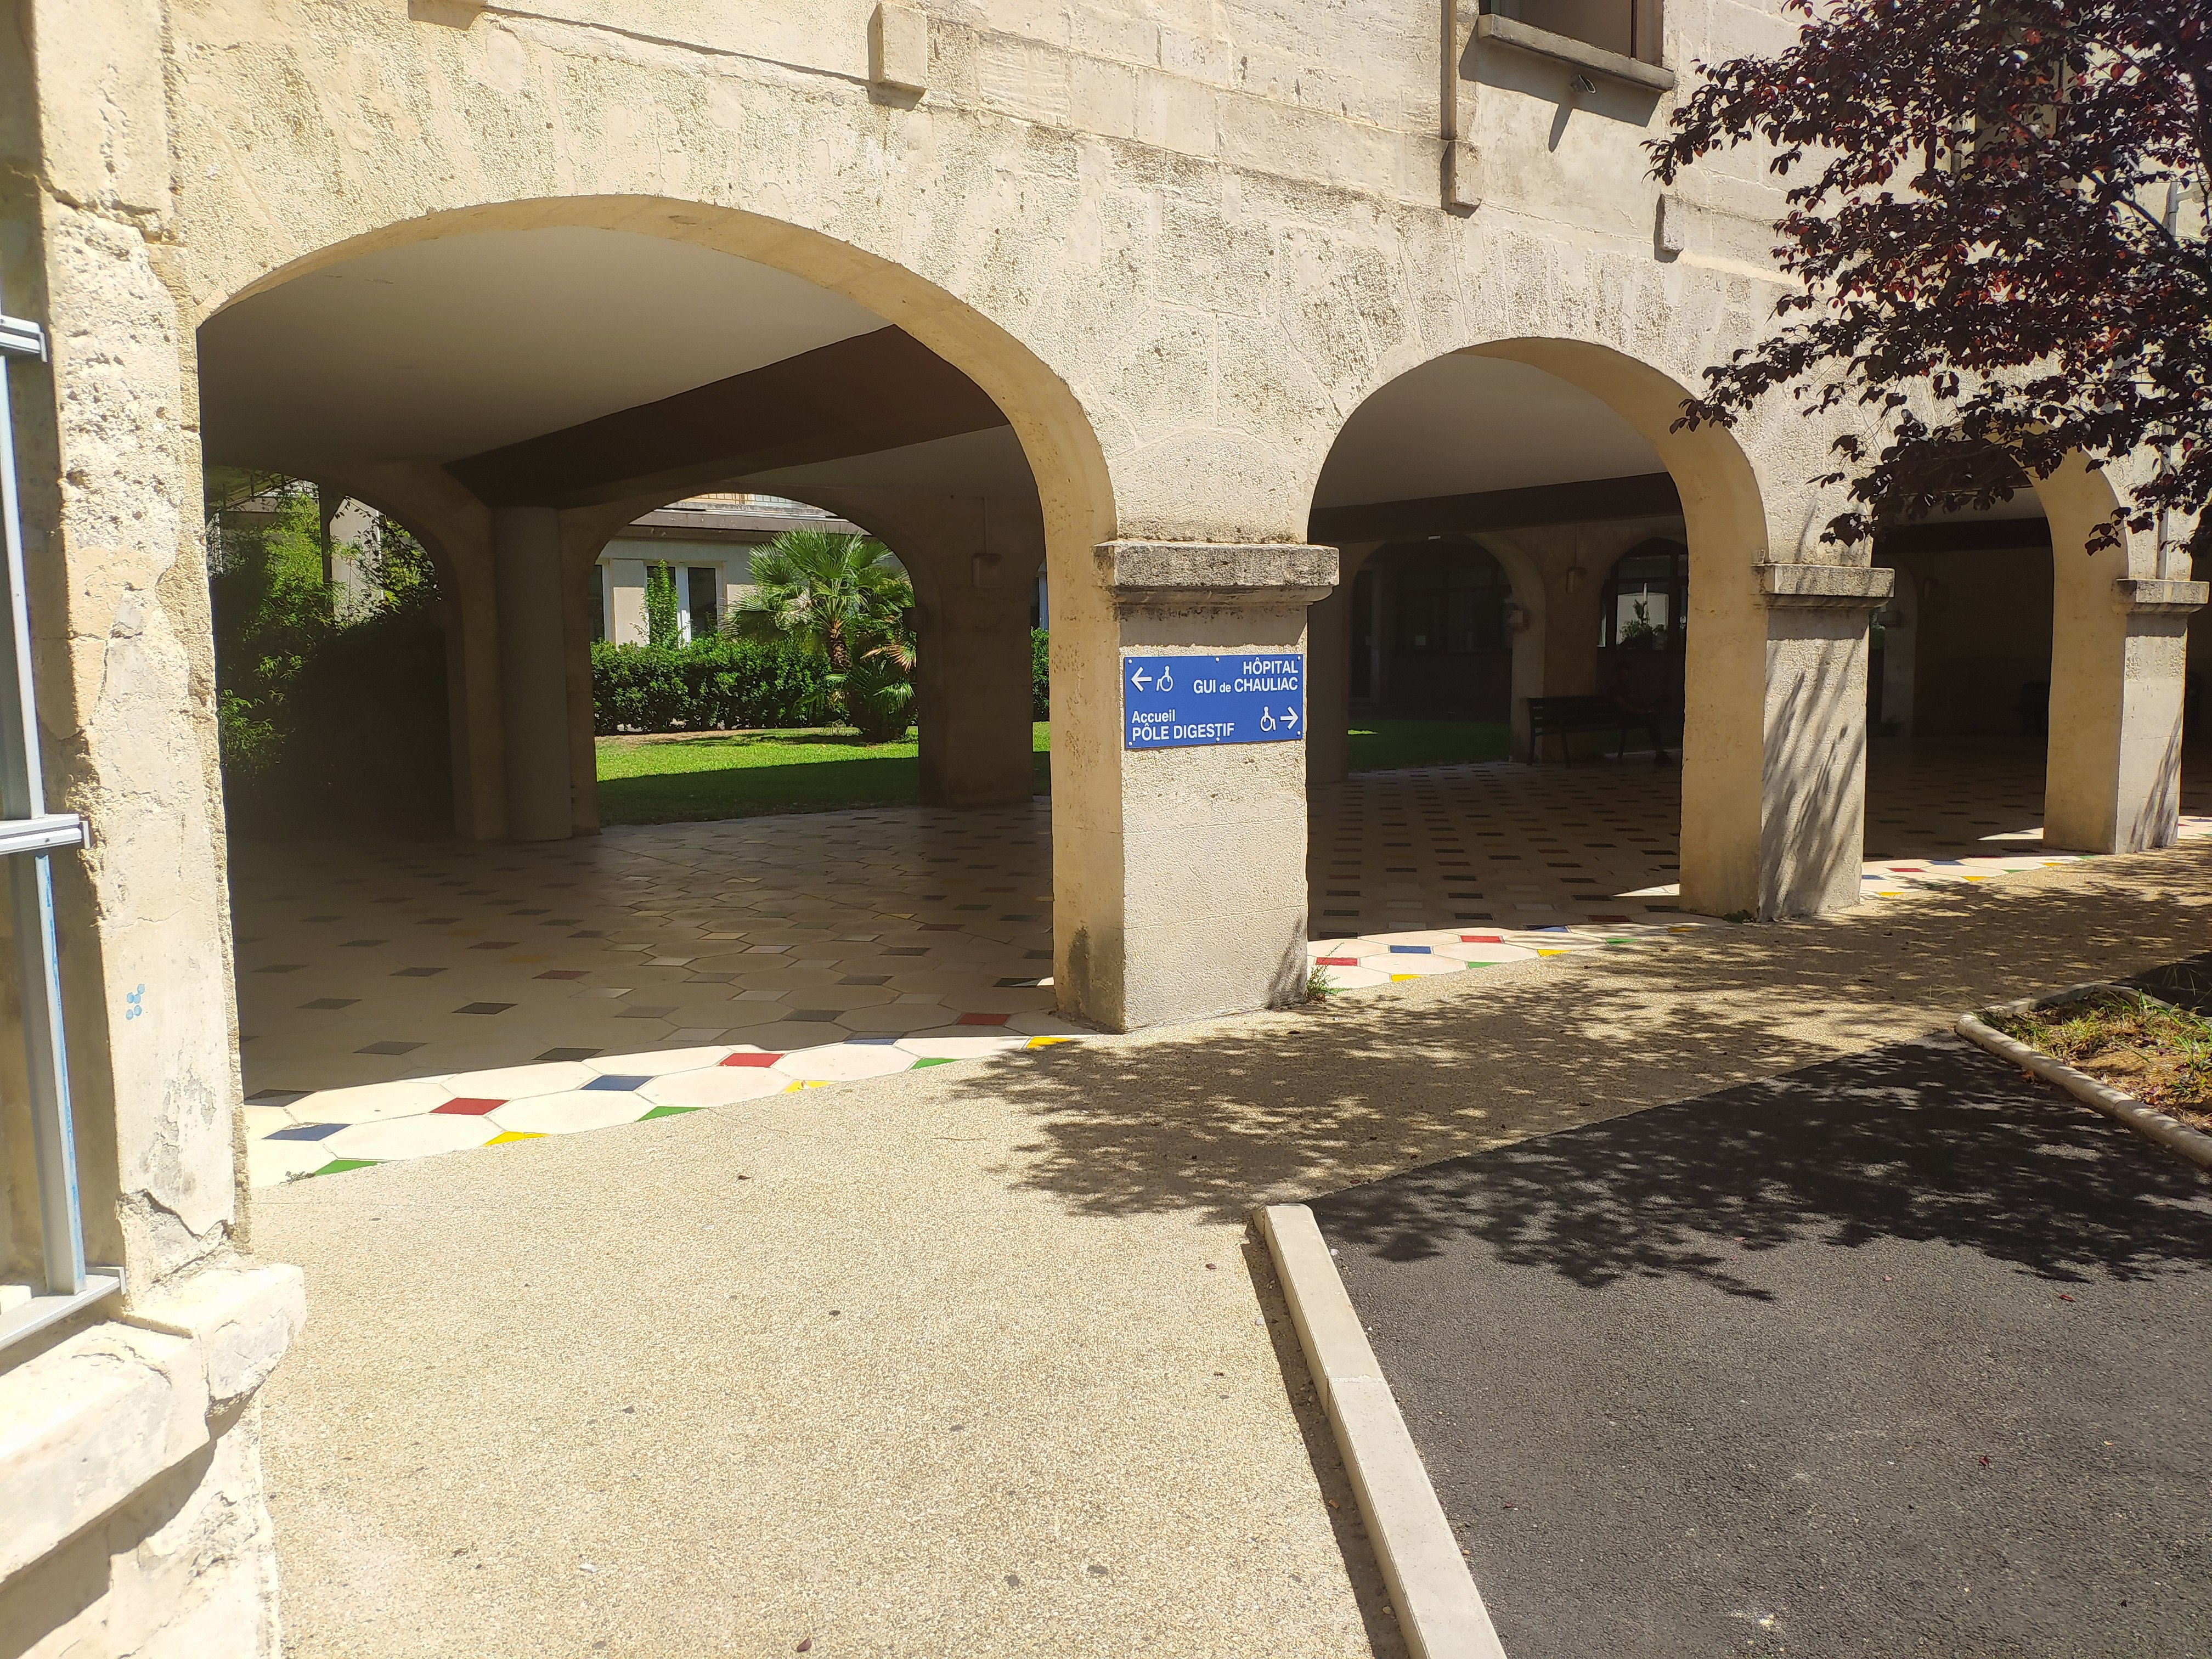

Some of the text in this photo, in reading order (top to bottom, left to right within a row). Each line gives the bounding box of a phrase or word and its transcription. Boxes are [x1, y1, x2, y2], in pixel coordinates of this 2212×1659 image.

[1243, 657, 1299, 675] HÔPITAL
[1193, 676, 1298, 694] GUI de CHAULIAC
[1131, 709, 1175, 724] Accueil
[1132, 723, 1235, 741] PÔLE DIGESTIF
